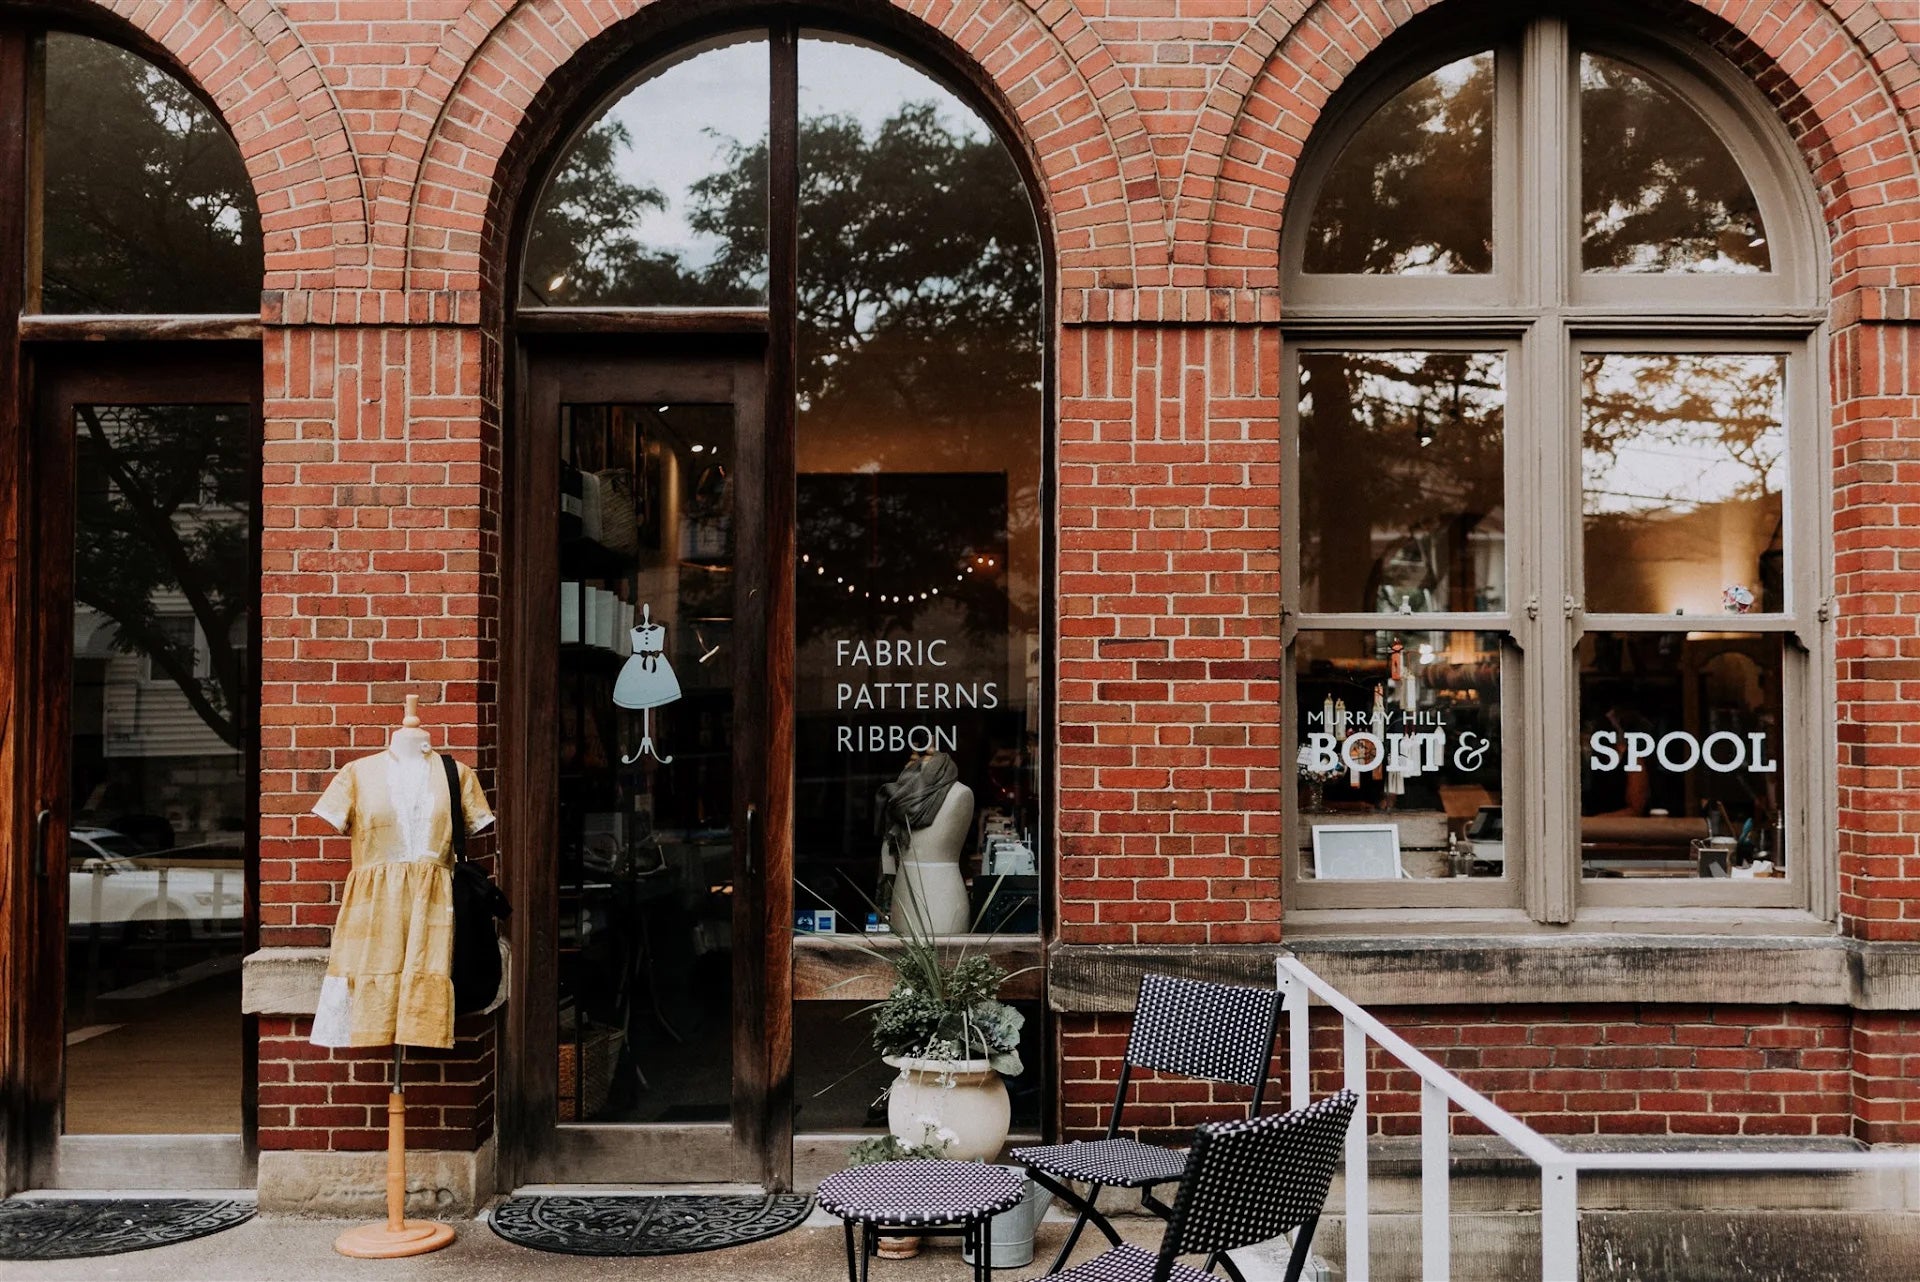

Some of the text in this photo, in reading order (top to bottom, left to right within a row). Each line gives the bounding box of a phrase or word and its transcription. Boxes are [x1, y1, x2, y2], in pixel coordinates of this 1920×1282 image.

[837, 639, 947, 667] FABRIC
[837, 682, 999, 710] PATTERNS
[1307, 710, 1447, 726] MURRAY HILL
[837, 725, 958, 752] RIBBON
[1307, 730, 1777, 773] BOLT & SPOOL
